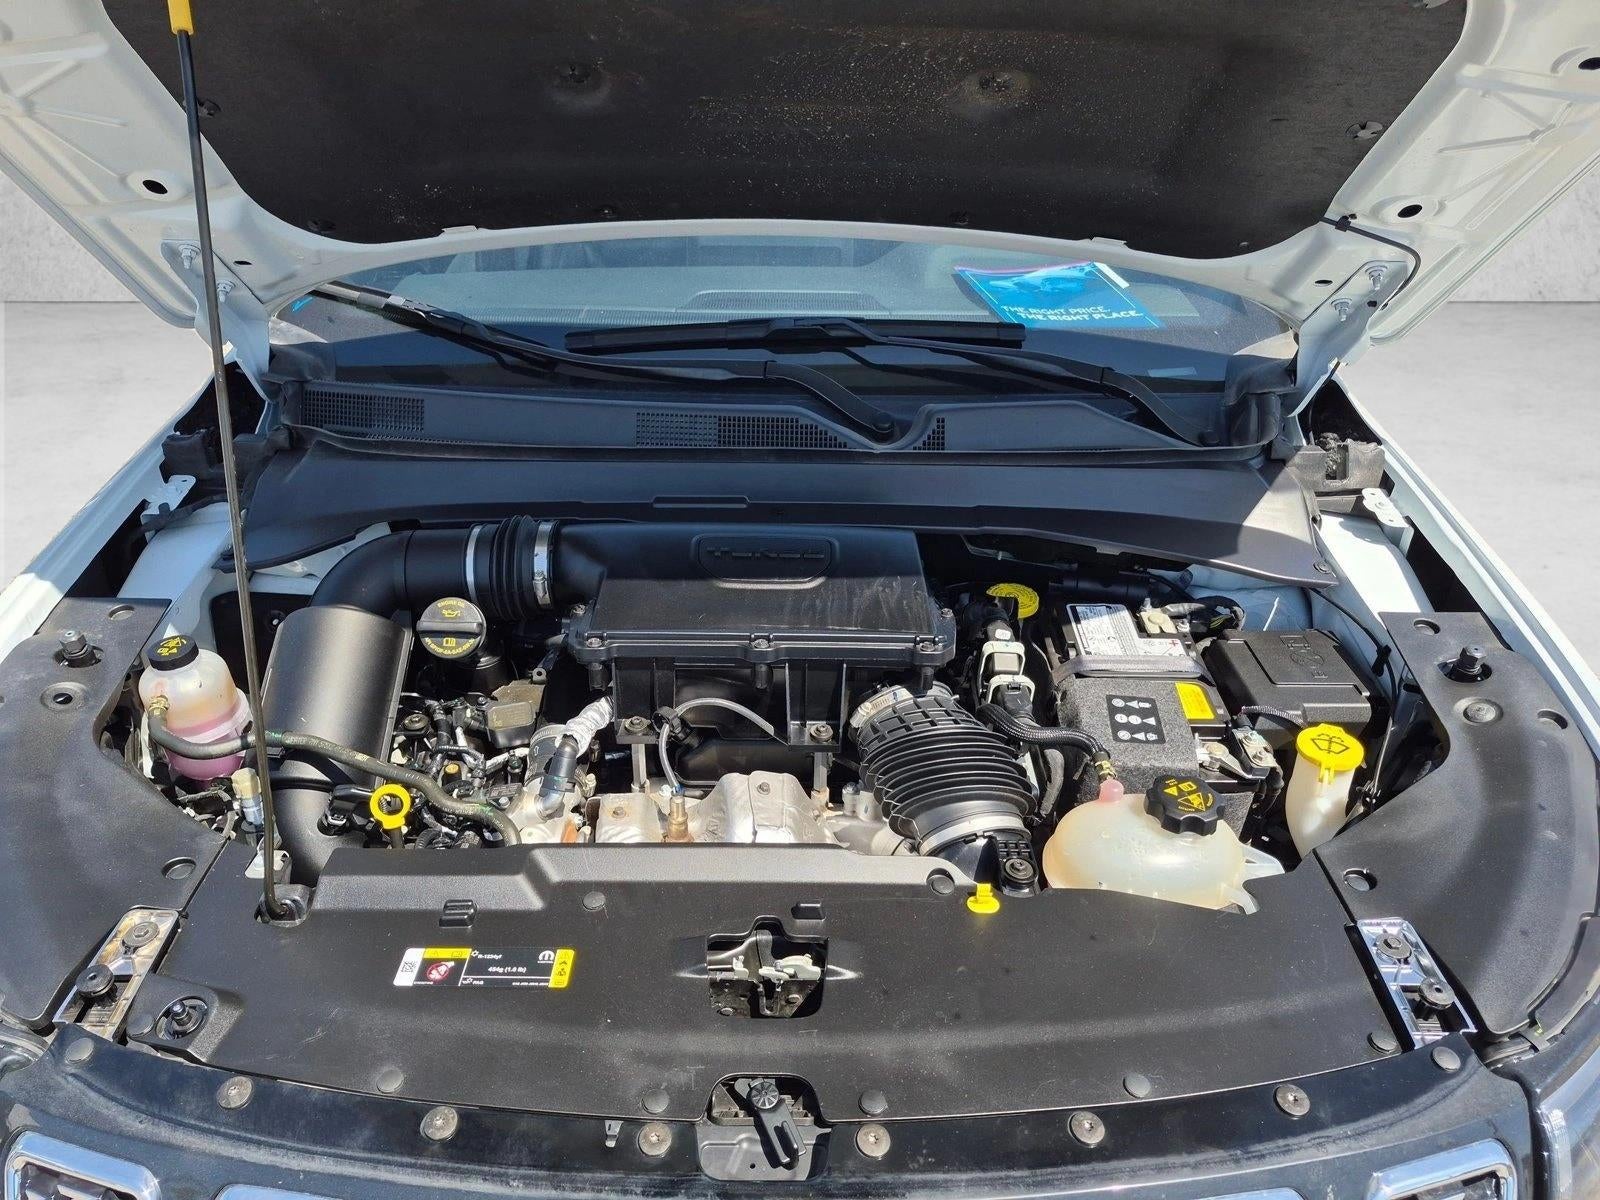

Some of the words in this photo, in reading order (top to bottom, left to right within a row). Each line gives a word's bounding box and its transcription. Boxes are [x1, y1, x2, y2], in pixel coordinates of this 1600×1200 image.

[1016, 312, 1049, 320] THE
[1048, 313, 1091, 321] RIGHT
[1093, 310, 1144, 319] PLACE.
[1028, 307, 1065, 315] RIGHT
